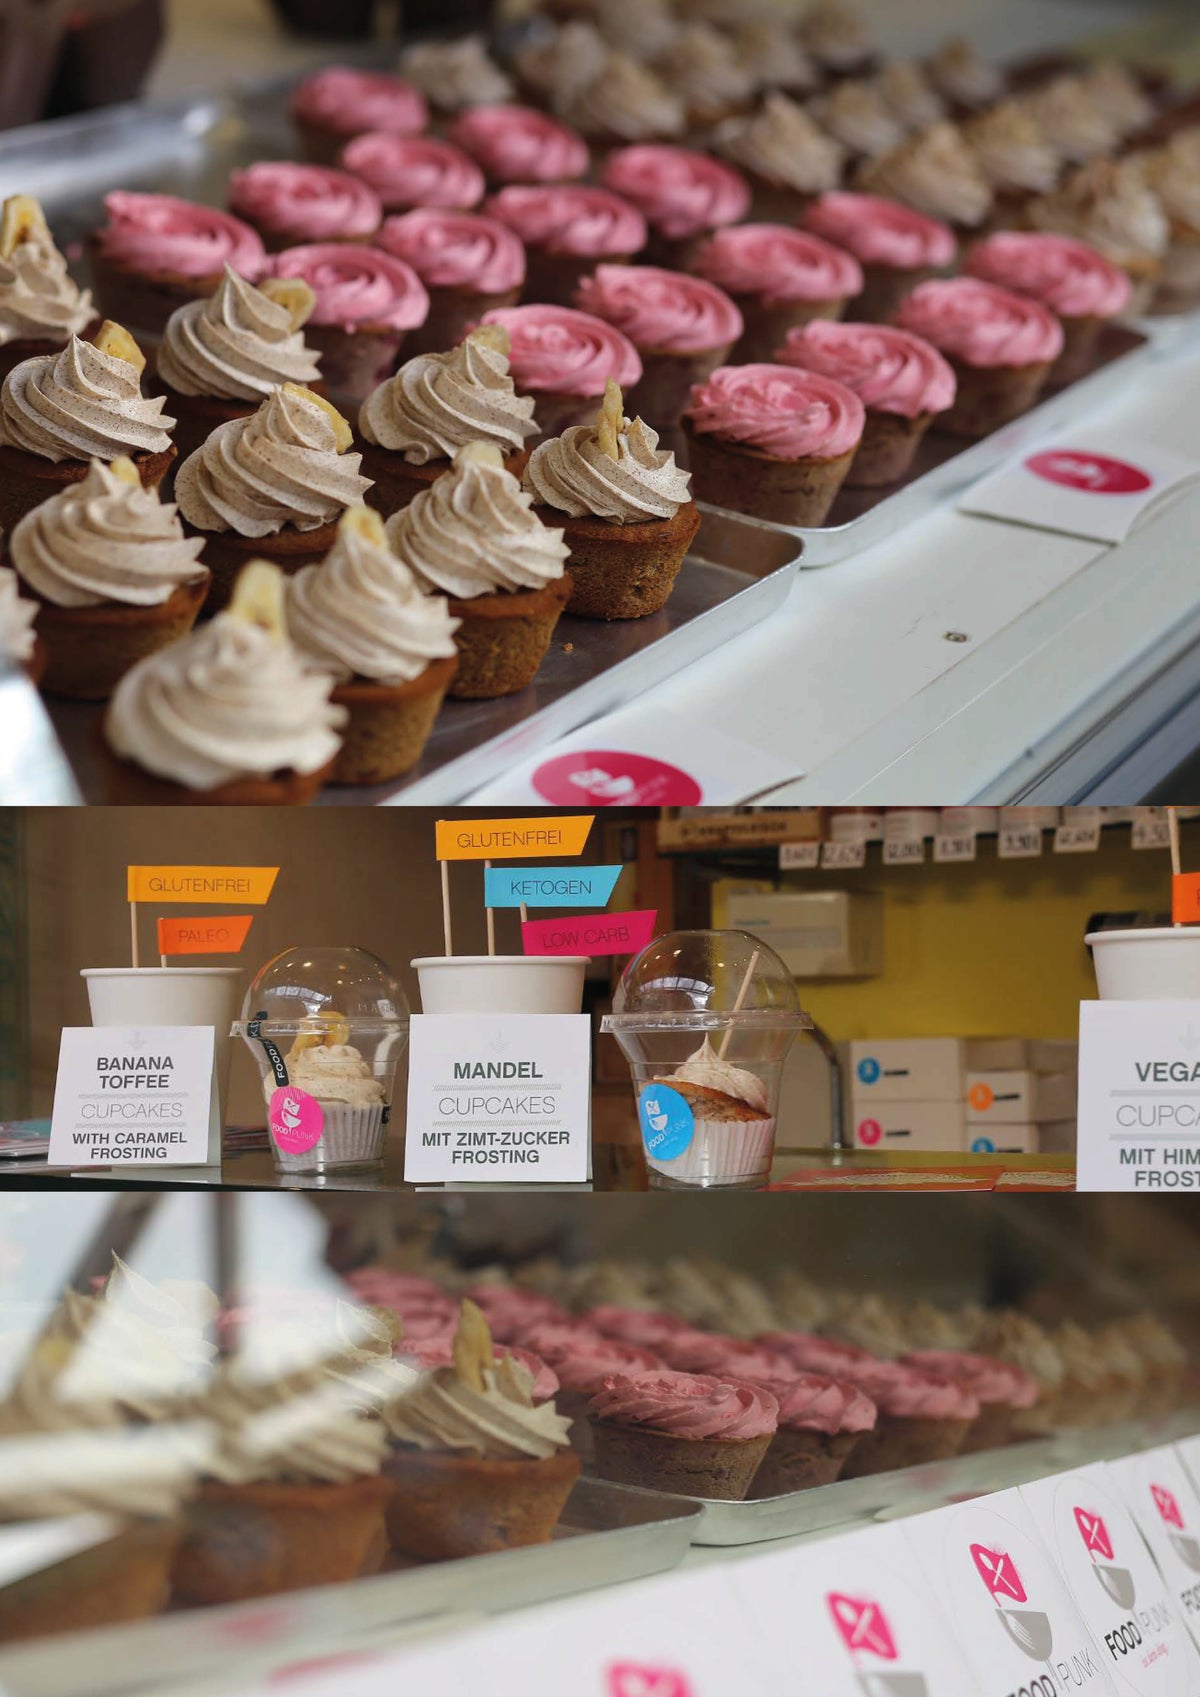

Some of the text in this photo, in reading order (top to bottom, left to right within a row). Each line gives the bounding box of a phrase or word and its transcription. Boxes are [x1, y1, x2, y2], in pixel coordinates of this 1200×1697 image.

[456, 829, 562, 848] GLUTENFREI
[148, 877, 251, 893] GLUTENFREI
[510, 879, 592, 896] KETOGEN
[178, 928, 230, 943] PALEO
[542, 926, 630, 949] LOW CARB
[96, 1056, 174, 1071] BANANA
[453, 1061, 544, 1080] MANDEL
[99, 1074, 170, 1090] TOFFEE
[81, 1102, 183, 1119] CUPCAKES
[438, 1095, 556, 1116] CUPCAKES
[1116, 1104, 1200, 1127] CUPC
[72, 1131, 188, 1145] WITH CARAMEL
[421, 1130, 571, 1147] MIT ZIMT-ZUCKER
[90, 1146, 168, 1160] FROSTING
[452, 1149, 540, 1165] FROSTING
[1120, 1147, 1200, 1165] MIT HIM
[1104, 1620, 1142, 1661] FOOD
[1056, 1648, 1099, 1693] PUNK
